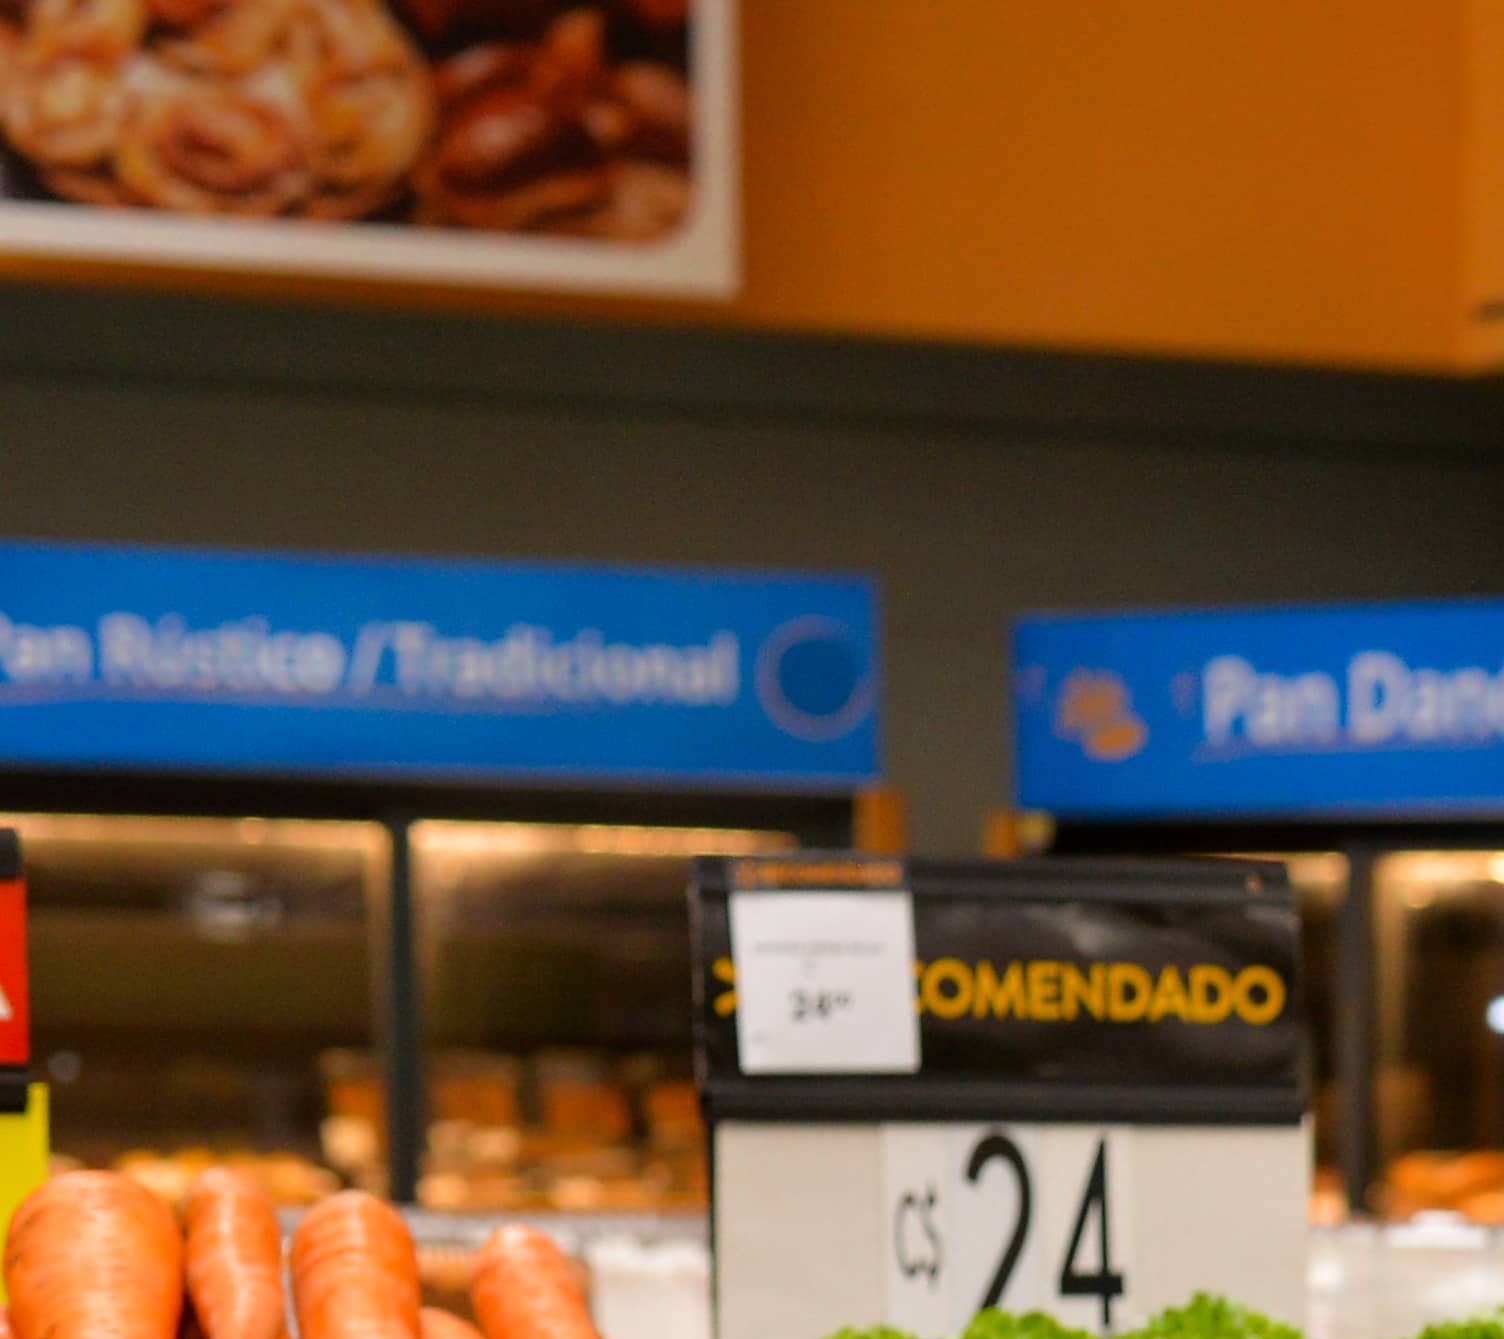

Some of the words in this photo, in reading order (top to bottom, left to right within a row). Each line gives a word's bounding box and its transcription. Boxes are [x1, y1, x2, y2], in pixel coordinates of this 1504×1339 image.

[0, 608, 92, 688] an
[1203, 655, 1341, 747] Pan
[912, 956, 1287, 1026] OMENDADO
